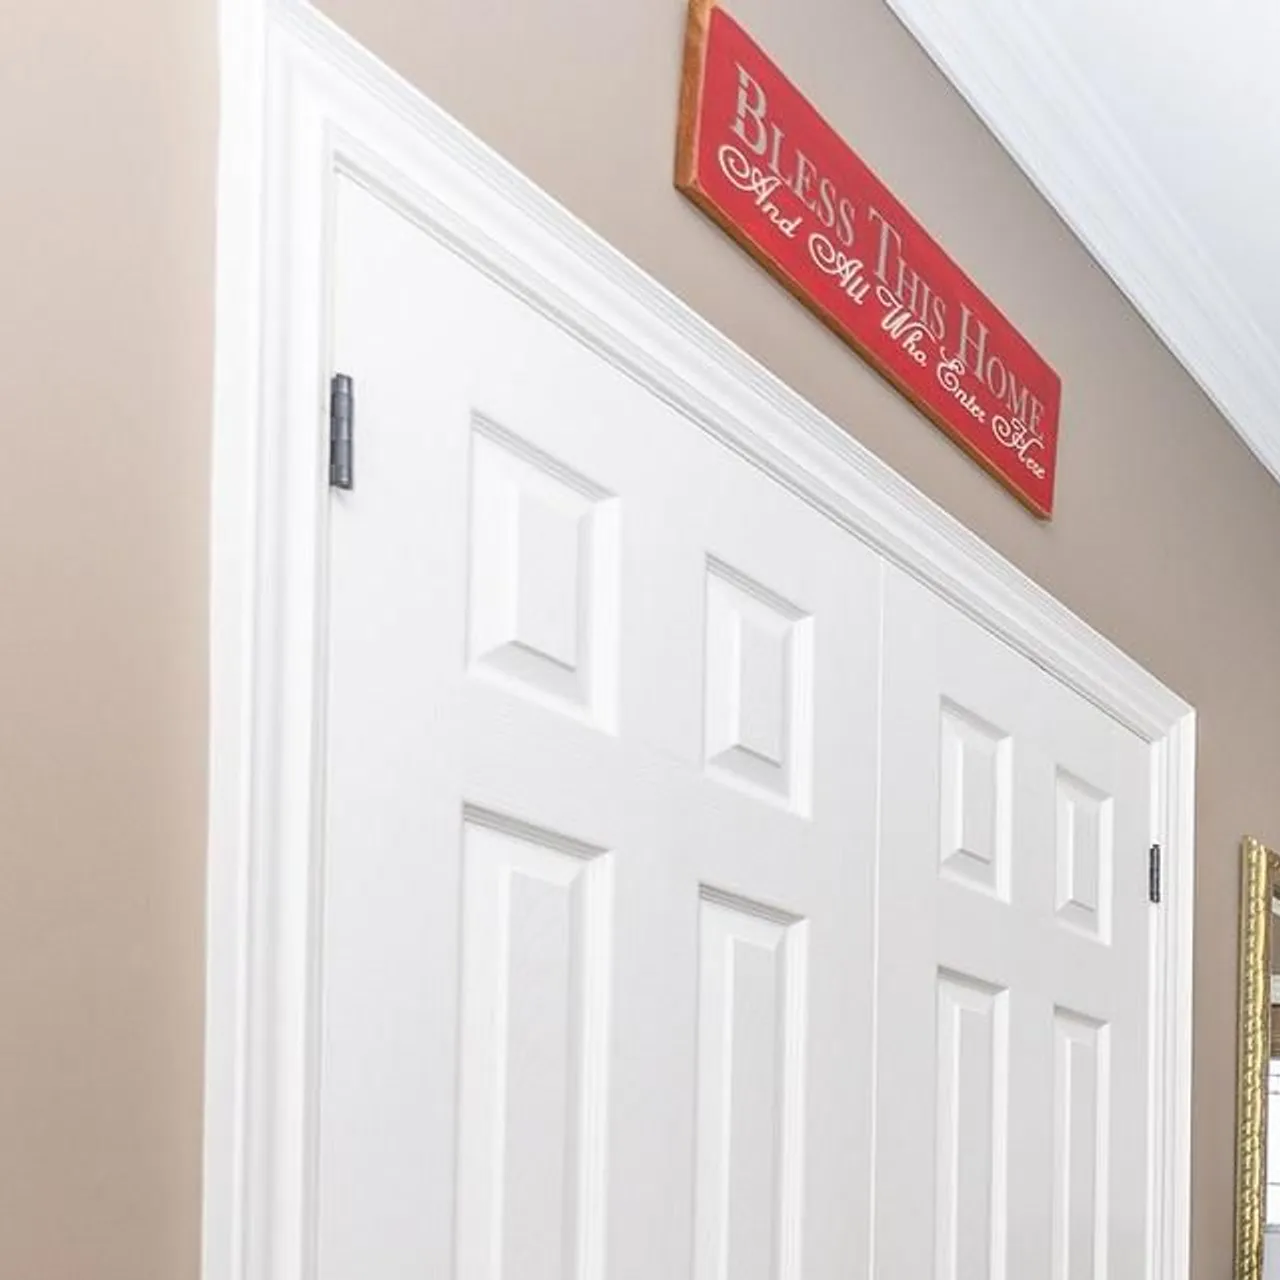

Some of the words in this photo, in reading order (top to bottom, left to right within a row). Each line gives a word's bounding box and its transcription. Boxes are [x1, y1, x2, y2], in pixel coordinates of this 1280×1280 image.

[717, 143, 803, 239] And
[807, 231, 871, 306] All
[875, 285, 937, 368] Who
[936, 346, 986, 424] Enter
[991, 415, 1048, 481] Here
